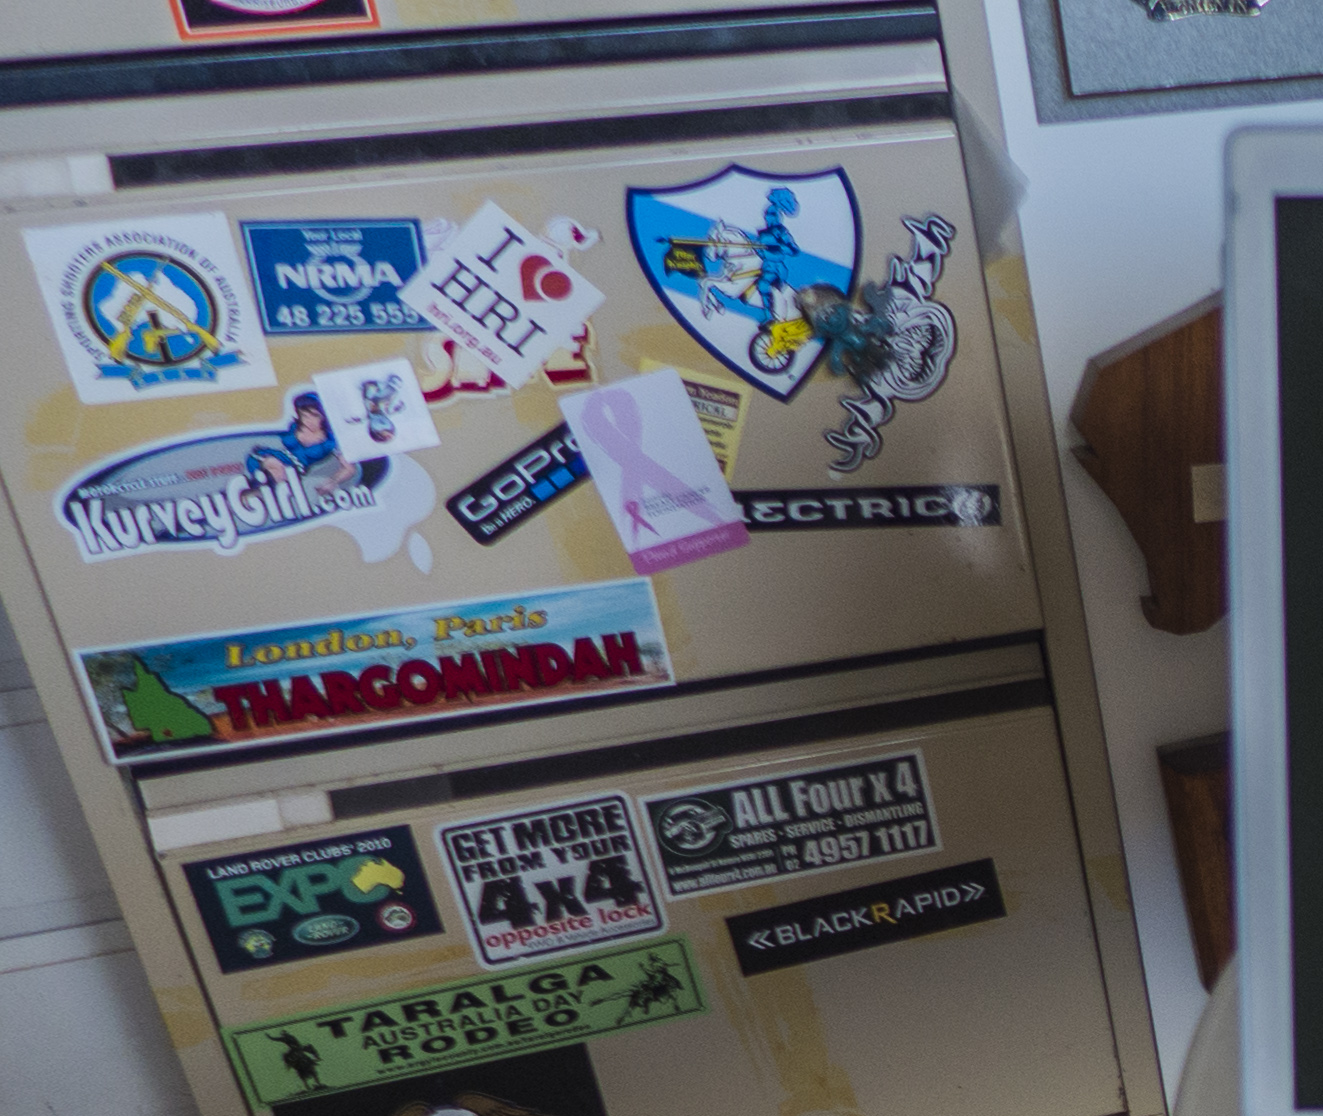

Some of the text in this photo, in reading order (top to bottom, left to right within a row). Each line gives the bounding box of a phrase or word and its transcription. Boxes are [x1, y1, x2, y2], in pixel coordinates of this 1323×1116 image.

[476, 226, 525, 274] I
[274, 261, 404, 290] NRMA
[276, 304, 312, 327] 48
[315, 303, 366, 326] 225
[431, 257, 548, 358] HRI
[223, 605, 549, 670] London, Paris
[211, 631, 645, 733] THARGOMINDAH
[895, 762, 921, 798] 4
[450, 804, 628, 864] GET MORE
[728, 802, 926, 850] SPARES SERVICE DISMANTLING
[802, 828, 872, 867] 4957
[874, 819, 929, 853] 1117
[206, 861, 250, 880] LAND
[250, 853, 302, 873] ROVER
[357, 837, 393, 853] 2010
[460, 851, 546, 883] FROM
[550, 833, 633, 864] YOUR
[213, 854, 394, 928] EXPO
[485, 903, 654, 950] opposite lock
[315, 964, 615, 1039] TARALGA
[360, 990, 590, 1051] AUSTRALIA DAY
[376, 1007, 582, 1065] RODEO
